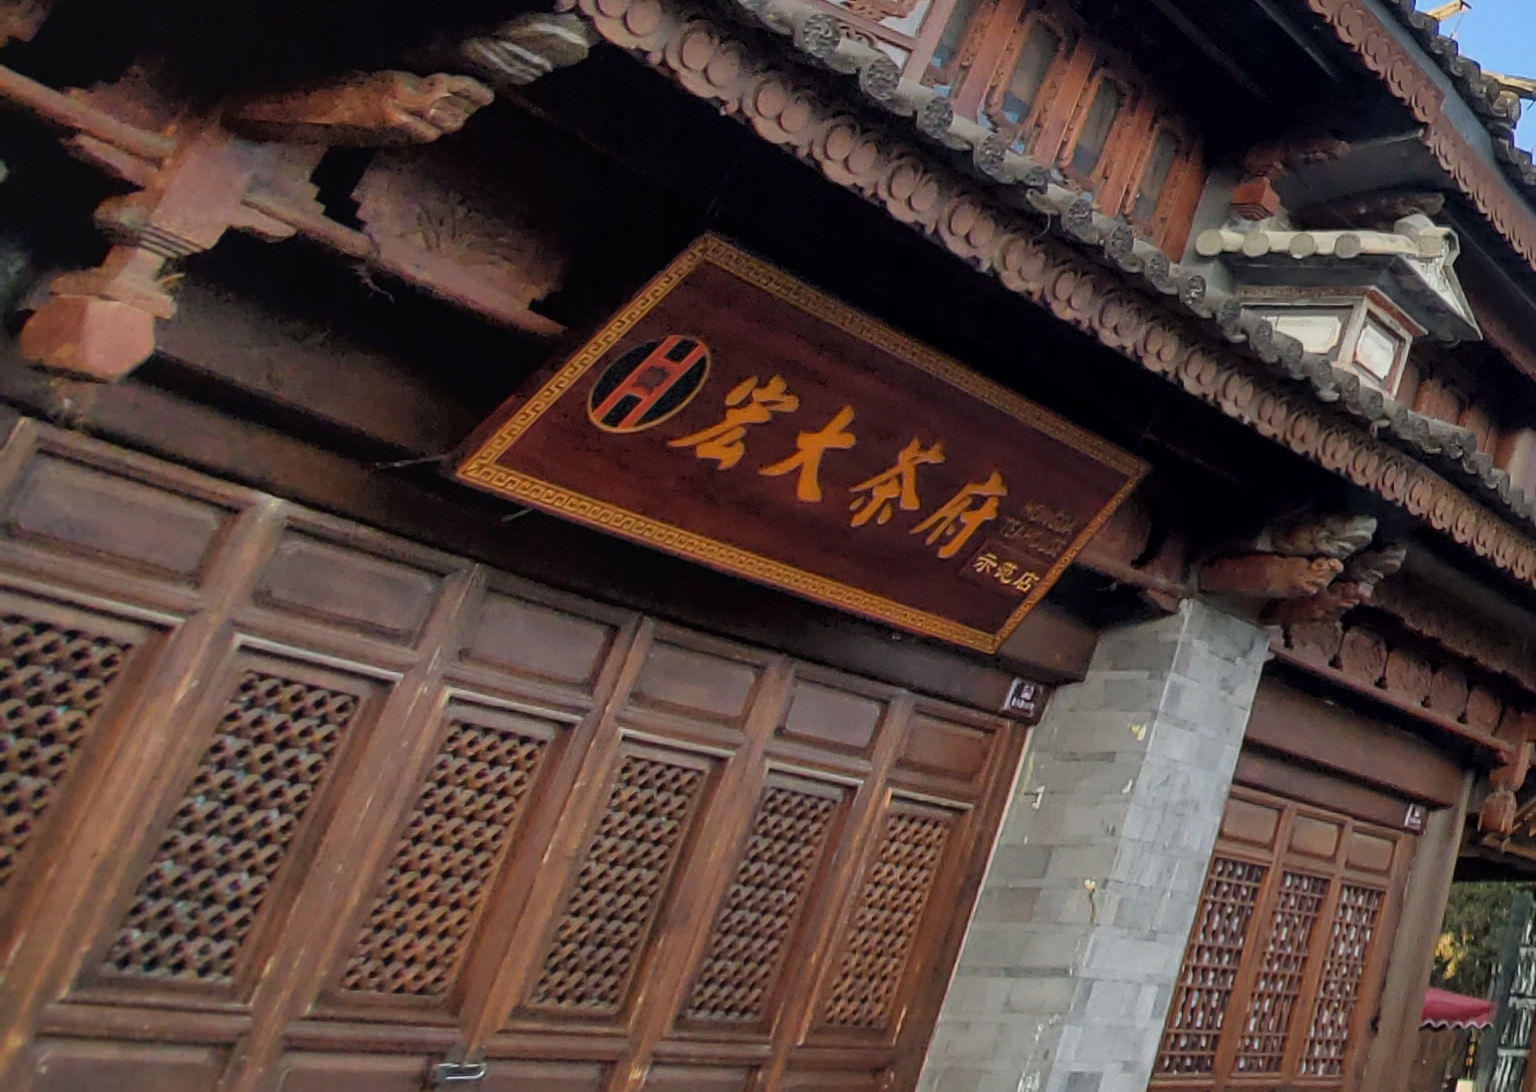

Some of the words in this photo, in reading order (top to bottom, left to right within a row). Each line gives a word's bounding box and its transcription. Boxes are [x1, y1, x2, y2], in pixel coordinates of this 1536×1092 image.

[667, 373, 1008, 559] 宏大茶府
[972, 551, 1040, 593] 示范店
